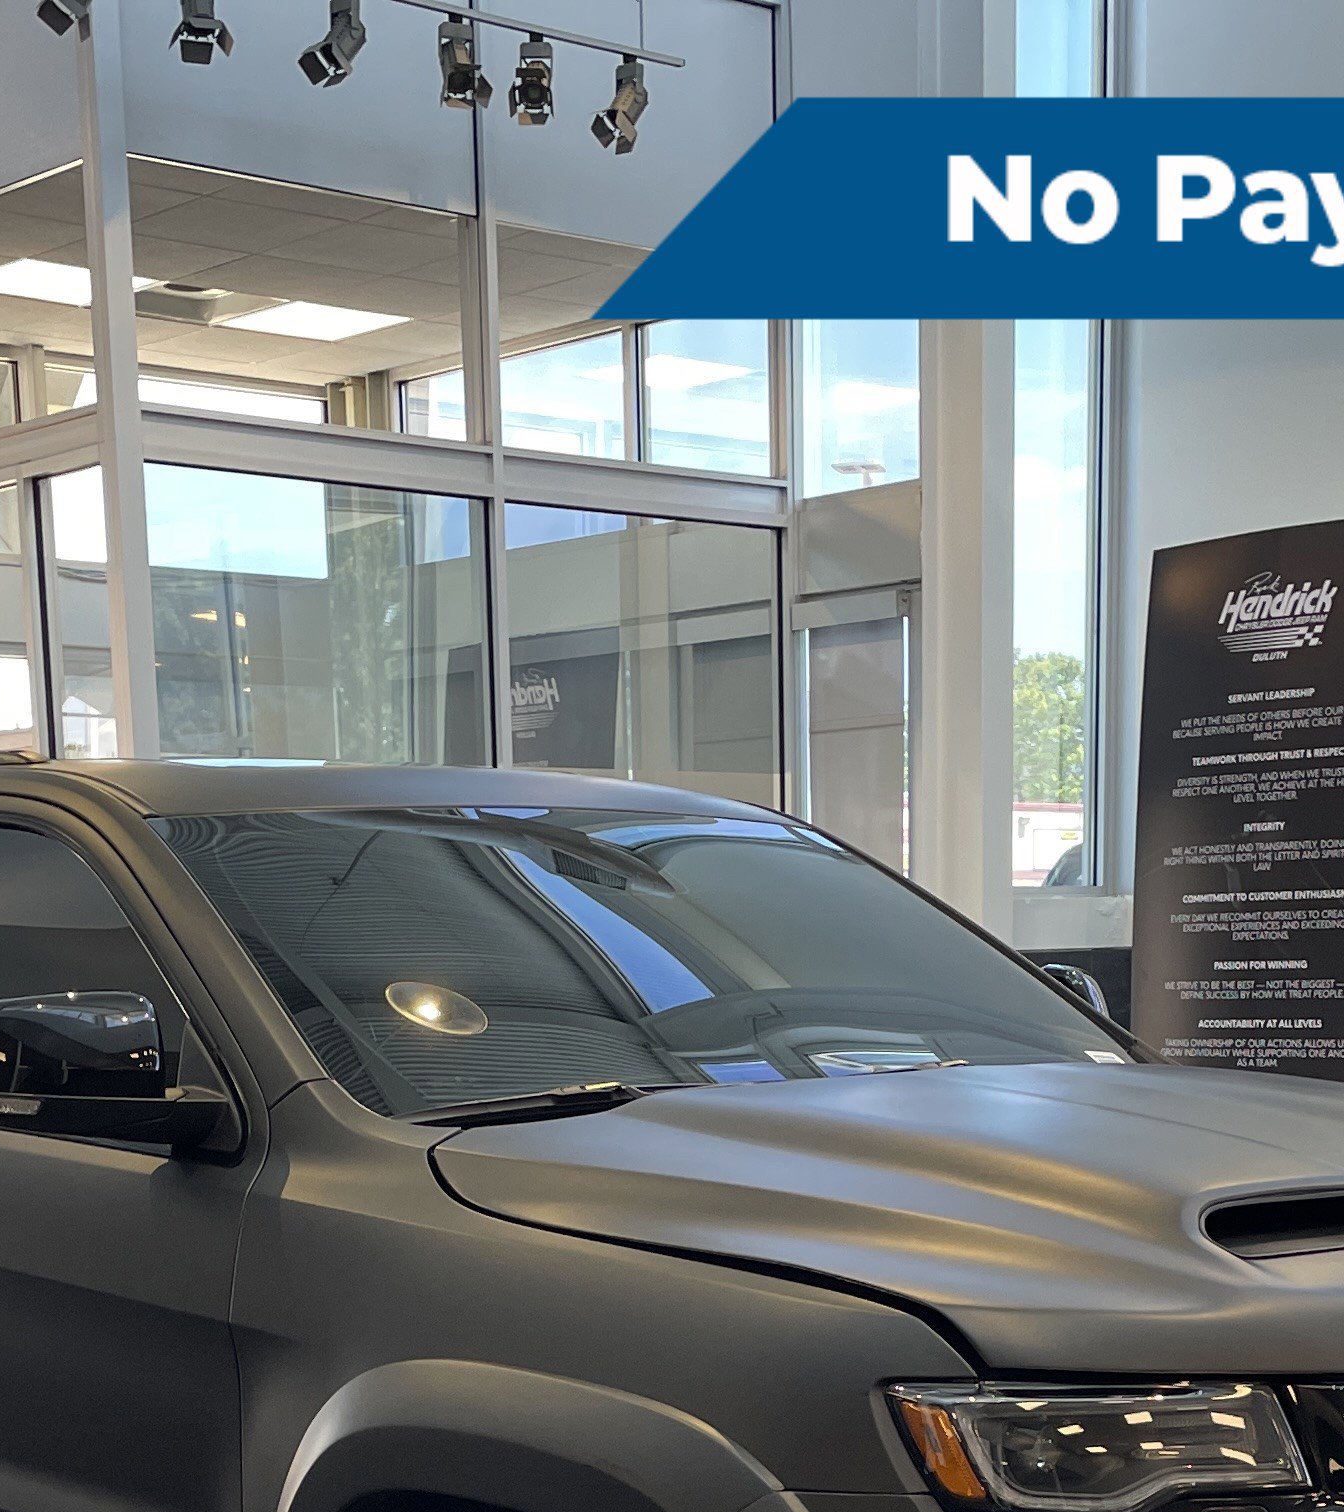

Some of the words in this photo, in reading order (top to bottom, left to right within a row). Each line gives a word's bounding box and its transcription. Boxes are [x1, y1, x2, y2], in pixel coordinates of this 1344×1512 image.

[1218, 579, 1338, 633] Hendrick
[1252, 651, 1288, 662] DULUTH
[1227, 691, 1264, 704] SERVANT
[1264, 687, 1315, 700] LEADERSHIP
[1181, 718, 1192, 728] WE
[1193, 717, 1207, 726] PUT
[1207, 715, 1221, 725] THE
[1222, 713, 1246, 724] NEEDS
[1246, 712, 1259, 722] OF
[1259, 709, 1291, 721] OTHERS
[1291, 706, 1323, 719] BEFORE
[1324, 705, 1344, 716] OUR
[1172, 727, 1203, 739] BECAUSE
[1203, 724, 1235, 736] SERVING
[1236, 721, 1264, 733] PEOPLE
[1264, 721, 1273, 731] IS
[1273, 719, 1296, 730] HOW
[1296, 718, 1310, 729] WE
[1311, 715, 1343, 728] CREATE
[1192, 754, 1237, 767] TEAMWORK
[1237, 751, 1279, 763] THROUGH
[1279, 749, 1305, 760] TRUST
[1306, 748, 1312, 759] &
[1177, 776, 1211, 787] DIVERSITY
[1260, 771, 1279, 781] AND
[1279, 769, 1306, 780] WHEN
[1305, 768, 1320, 779] WE
[1172, 786, 1201, 798] RESPECT
[1201, 784, 1218, 795] ONE
[1257, 781, 1271, 791] WE
[1271, 779, 1307, 791] ACHIEVE
[1307, 778, 1319, 789] AT
[1319, 777, 1336, 788] THE
[1233, 793, 1255, 803] LEVEL
[1243, 821, 1285, 832] INTEGRITY
[1171, 846, 1183, 856] WE
[1183, 845, 1198, 855] ACT
[1198, 844, 1236, 855] HONESTLY
[1236, 842, 1255, 852] AND
[1182, 892, 1235, 904] COMMITMENT
[1235, 892, 1248, 902] TO
[1248, 890, 1293, 901] CUSTOMER
[1170, 913, 1191, 923] EVERY
[1191, 912, 1206, 922] DAY
[1206, 912, 1219, 922] WE
[1219, 911, 1262, 922] RECOMMIT
[1262, 910, 1307, 921] OURSELVES
[1308, 909, 1320, 919] TO
[1182, 922, 1230, 933] EXCEPTIONAL
[1230, 920, 1281, 931] EXPERIENCES
[1281, 920, 1300, 930] AND
[1213, 960, 1248, 971] PASSION
[1249, 960, 1266, 970] FOR
[1267, 959, 1308, 970] WINNING
[1164, 981, 1176, 990] WE
[1176, 980, 1198, 990] STRIVE
[1199, 980, 1210, 990] TO
[1210, 980, 1221, 990] BE
[1221, 980, 1236, 990] THE
[1236, 980, 1255, 990] BEST
[1265, 980, 1284, 989] NOT
[1285, 979, 1300, 989] THE
[1301, 979, 1335, 989] BIGGEST
[1180, 990, 1204, 1000] DEFINE
[1205, 990, 1239, 1000] SUCCESS
[1240, 990, 1251, 1000] BY
[1251, 990, 1274, 1000] HOW
[1274, 989, 1287, 999] WE
[1288, 989, 1313, 999] TREAT
[1198, 1019, 1265, 1029] ACCOUNTABILITY
[1266, 1019, 1278, 1029] AT
[1278, 1019, 1293, 1029] ALL
[1294, 1019, 1323, 1029] LEVELS
[1165, 1038, 1190, 1048] TAKING
[1190, 1038, 1234, 1048] OWNERSHIP
[1235, 1038, 1247, 1048] OF
[1247, 1038, 1266, 1048] OUR
[1267, 1038, 1303, 1048] ACTIONS
[1303, 1038, 1337, 1048] ALLOWS
[1160, 1047, 1183, 1057] GROW
[1183, 1047, 1231, 1057] INDIVIDUALLY
[1231, 1048, 1255, 1057] WHILE
[1256, 1048, 1307, 1058] SUPPORTING
[1308, 1048, 1326, 1058] ONE
[1236, 1058, 1247, 1067] AS
